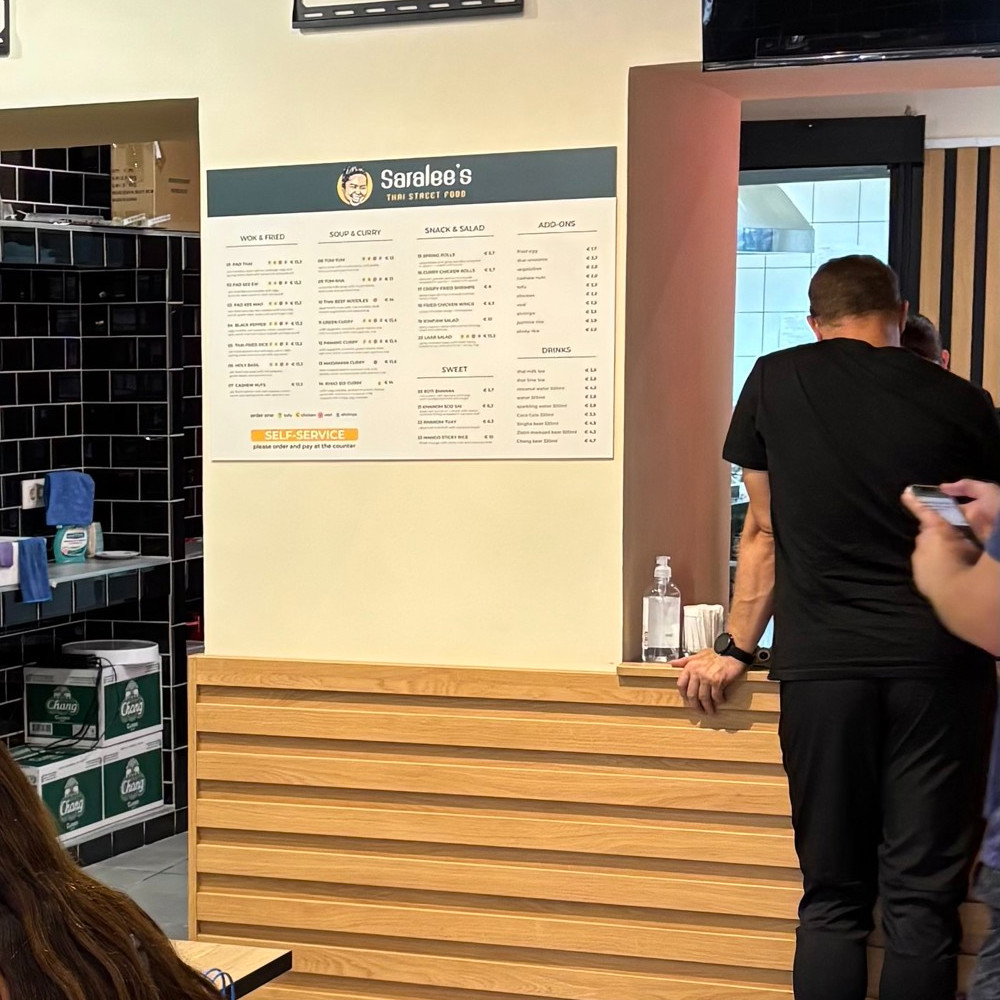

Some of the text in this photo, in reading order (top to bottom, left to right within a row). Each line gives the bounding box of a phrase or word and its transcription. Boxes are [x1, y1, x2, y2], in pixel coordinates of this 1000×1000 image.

[381, 163, 473, 190] Saralee's
[386, 189, 467, 202] THAI STREET FOOD
[424, 226, 451, 234] SNACK
[459, 224, 486, 232] SALAD
[538, 220, 576, 229] ADD-ONS
[329, 230, 350, 238] SOUP
[541, 346, 572, 354] DRINKS
[264, 429, 346, 440] SELF-SERVICE
[46, 699, 79, 713] Chang
[120, 701, 144, 717] Chang
[120, 779, 145, 795] Chang
[60, 799, 84, 816] Chang
